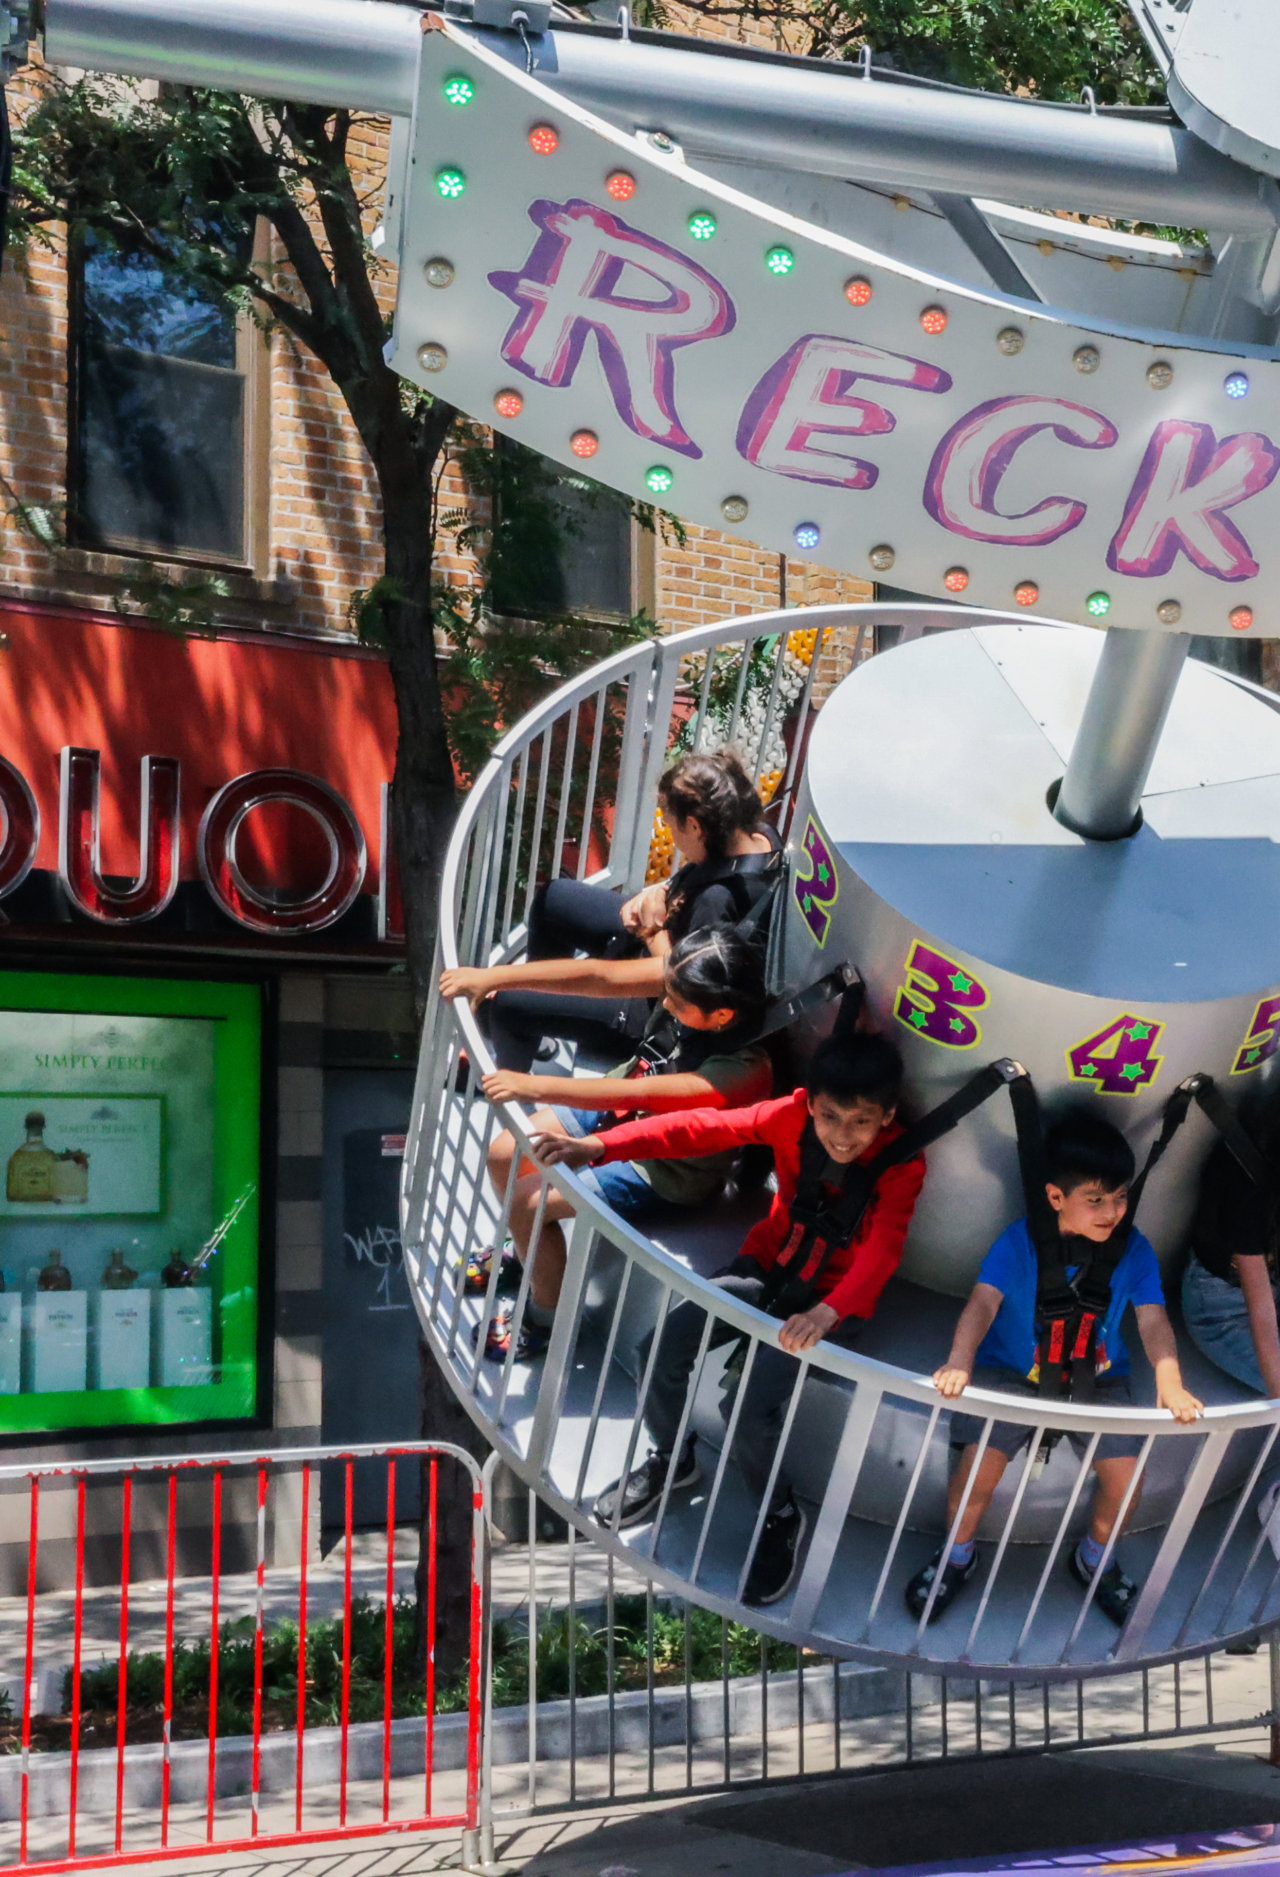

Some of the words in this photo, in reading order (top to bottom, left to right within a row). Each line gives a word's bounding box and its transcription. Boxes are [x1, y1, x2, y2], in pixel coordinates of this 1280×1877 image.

[0, 744, 405, 946] UO
[795, 814, 838, 949] 2
[893, 938, 990, 1050] 3
[1065, 1011, 1165, 1096] 4
